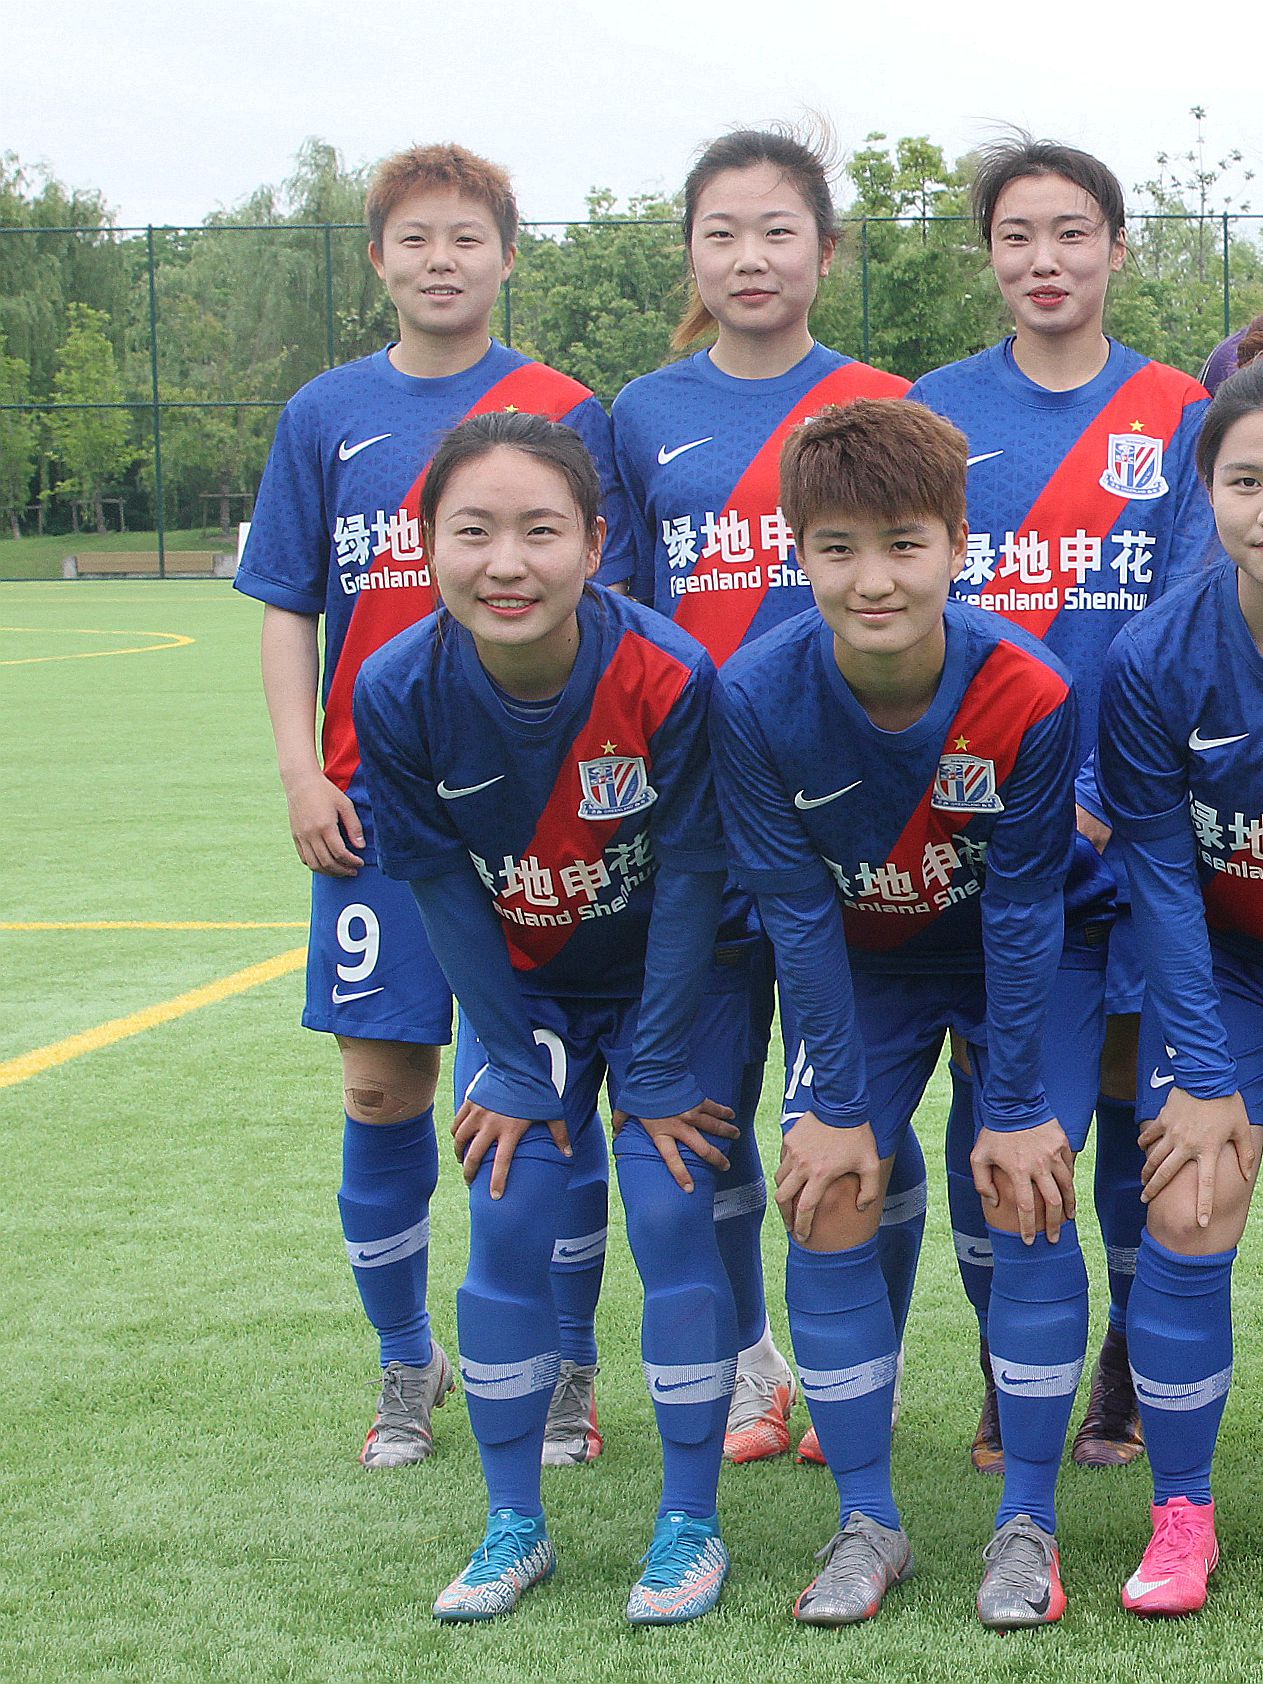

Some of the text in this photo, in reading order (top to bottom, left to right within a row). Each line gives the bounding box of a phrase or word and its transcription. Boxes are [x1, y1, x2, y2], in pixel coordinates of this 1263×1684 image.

[333, 508, 424, 567] 绿地
[1064, 586, 1148, 611] Shenhu
[336, 903, 380, 983] 9
